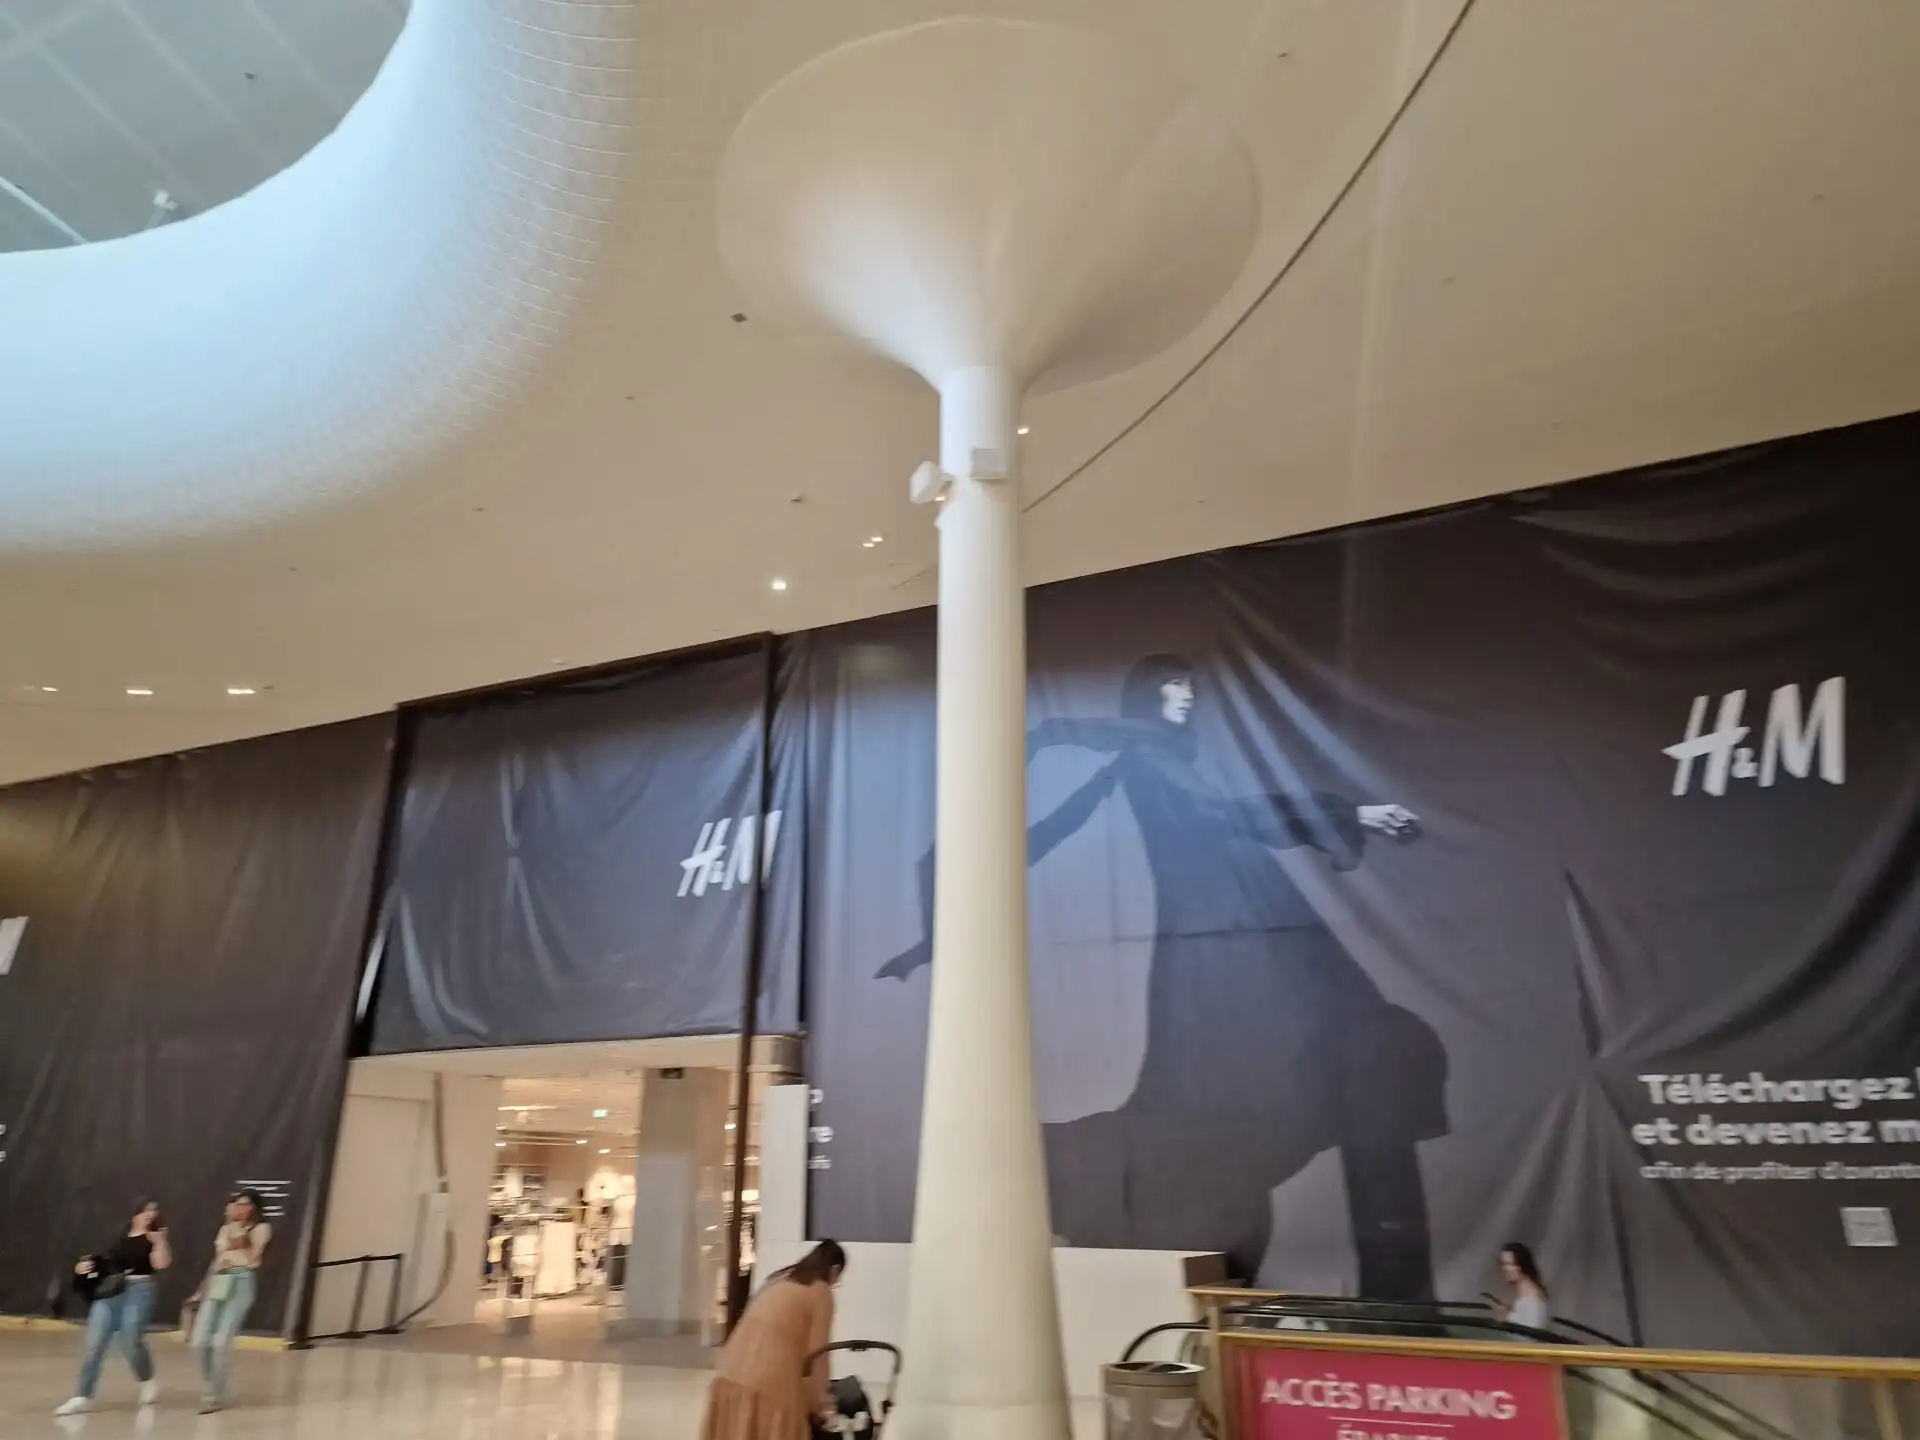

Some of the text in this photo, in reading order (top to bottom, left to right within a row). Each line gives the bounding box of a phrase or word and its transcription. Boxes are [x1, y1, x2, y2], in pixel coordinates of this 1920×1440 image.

[1662, 675, 1846, 797] H&M
[677, 810, 782, 896] H&M
[1638, 1072, 1915, 1109] Téléchargez
[1631, 1117, 1682, 1145] et
[1685, 1114, 1875, 1145] devenez
[1261, 1373, 1517, 1420] ACCÈS PARKING
